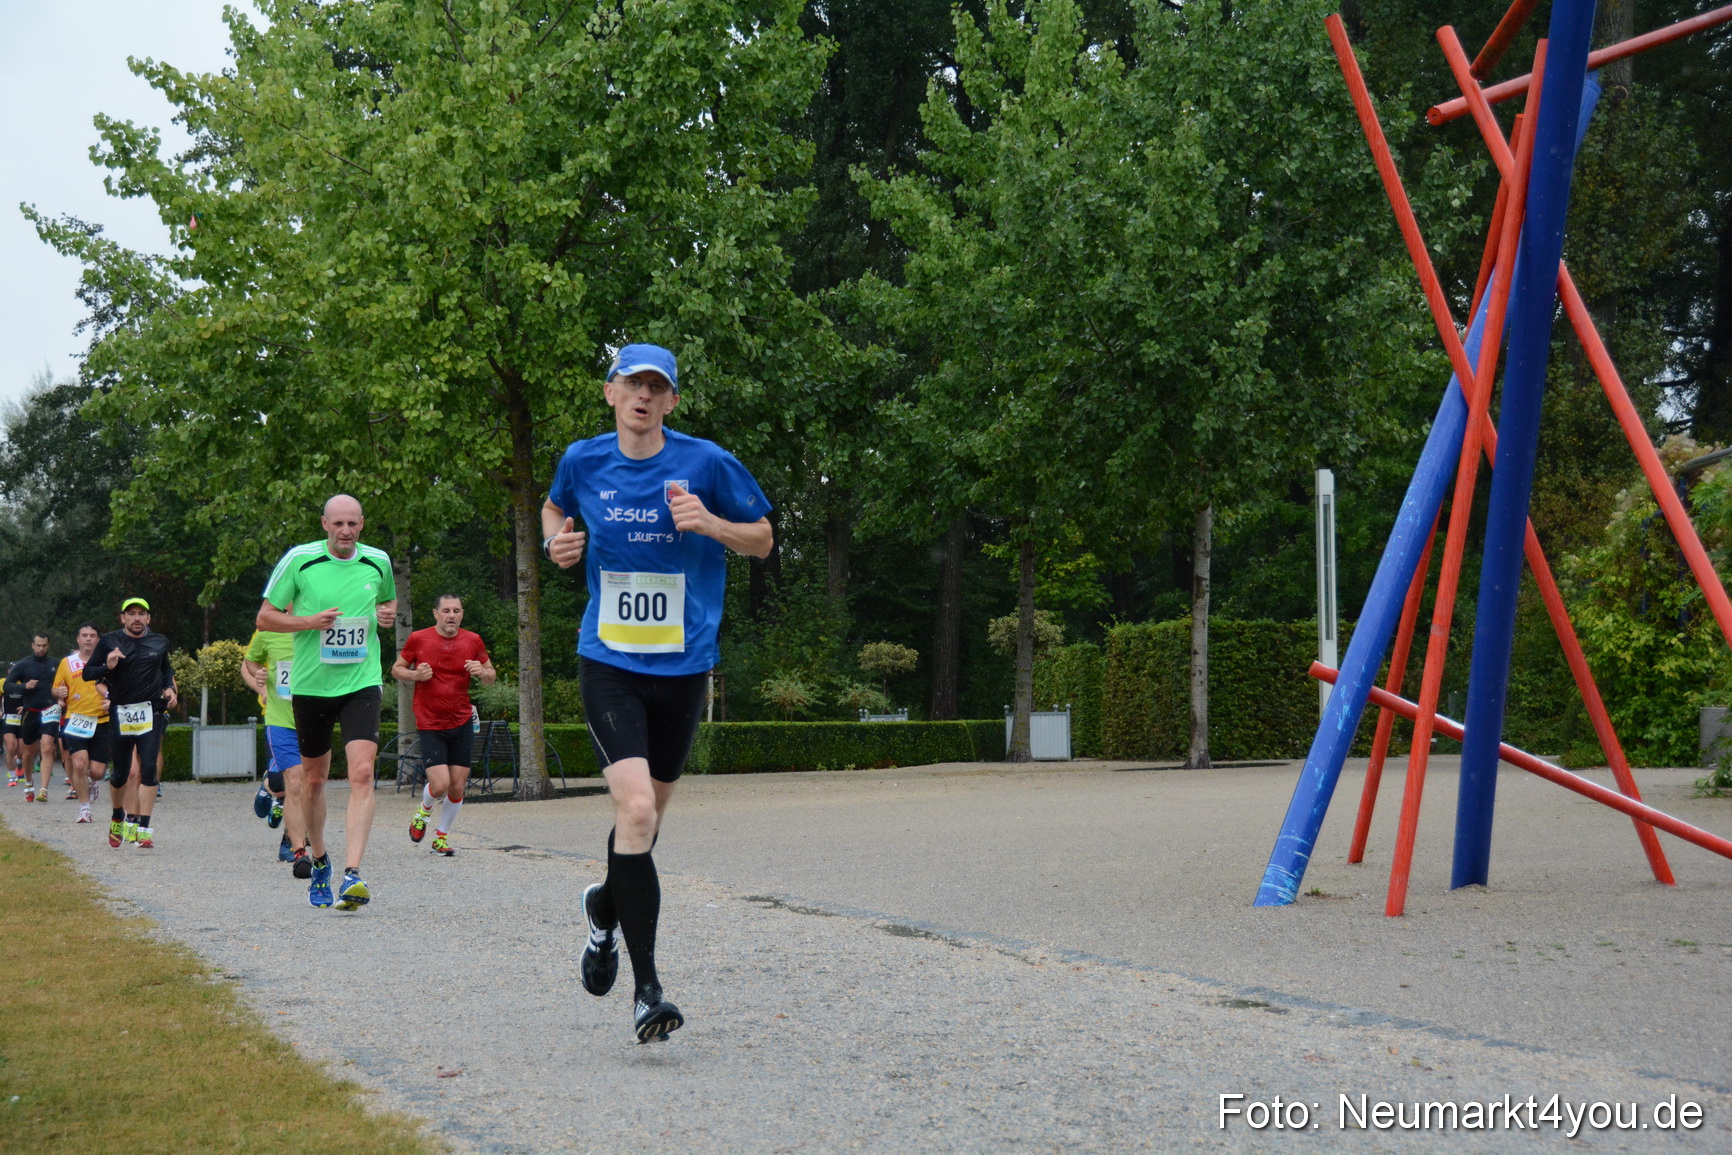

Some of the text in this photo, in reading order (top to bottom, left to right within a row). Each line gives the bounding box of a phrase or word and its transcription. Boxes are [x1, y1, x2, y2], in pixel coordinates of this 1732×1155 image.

[600, 490, 617, 500] MIT
[604, 507, 659, 523] JESUS
[628, 531, 674, 542] LÄUFT'S
[618, 591, 667, 622] 600
[325, 628, 364, 646] 2513
[125, 710, 146, 723] 344
